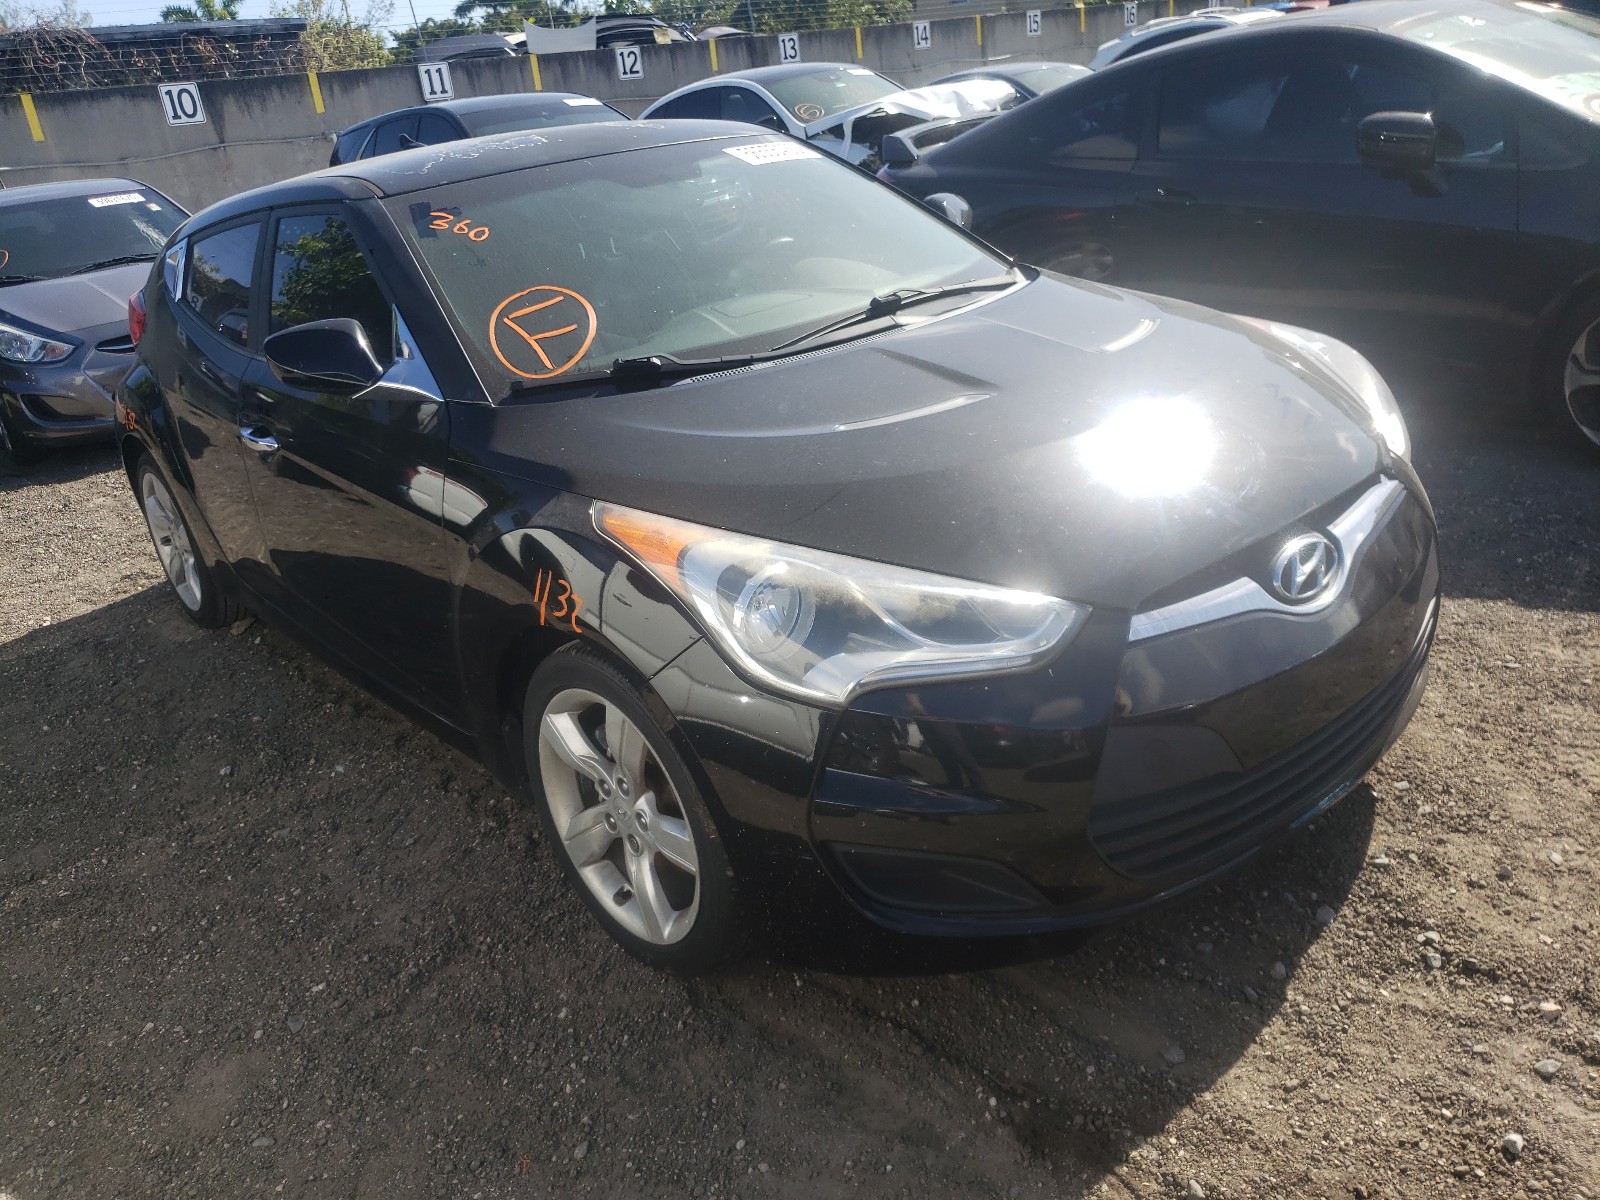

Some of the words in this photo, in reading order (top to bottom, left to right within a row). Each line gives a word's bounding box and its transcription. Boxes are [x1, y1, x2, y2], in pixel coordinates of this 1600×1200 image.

[915, 25, 929, 45] 14
[1028, 14, 1039, 33] 15
[781, 37, 798, 60] 13
[619, 50, 640, 76] 12
[424, 67, 449, 95] 11
[164, 88, 198, 120] 10
[428, 211, 490, 242] 360
[503, 295, 577, 370] F
[533, 567, 584, 634] 1132
